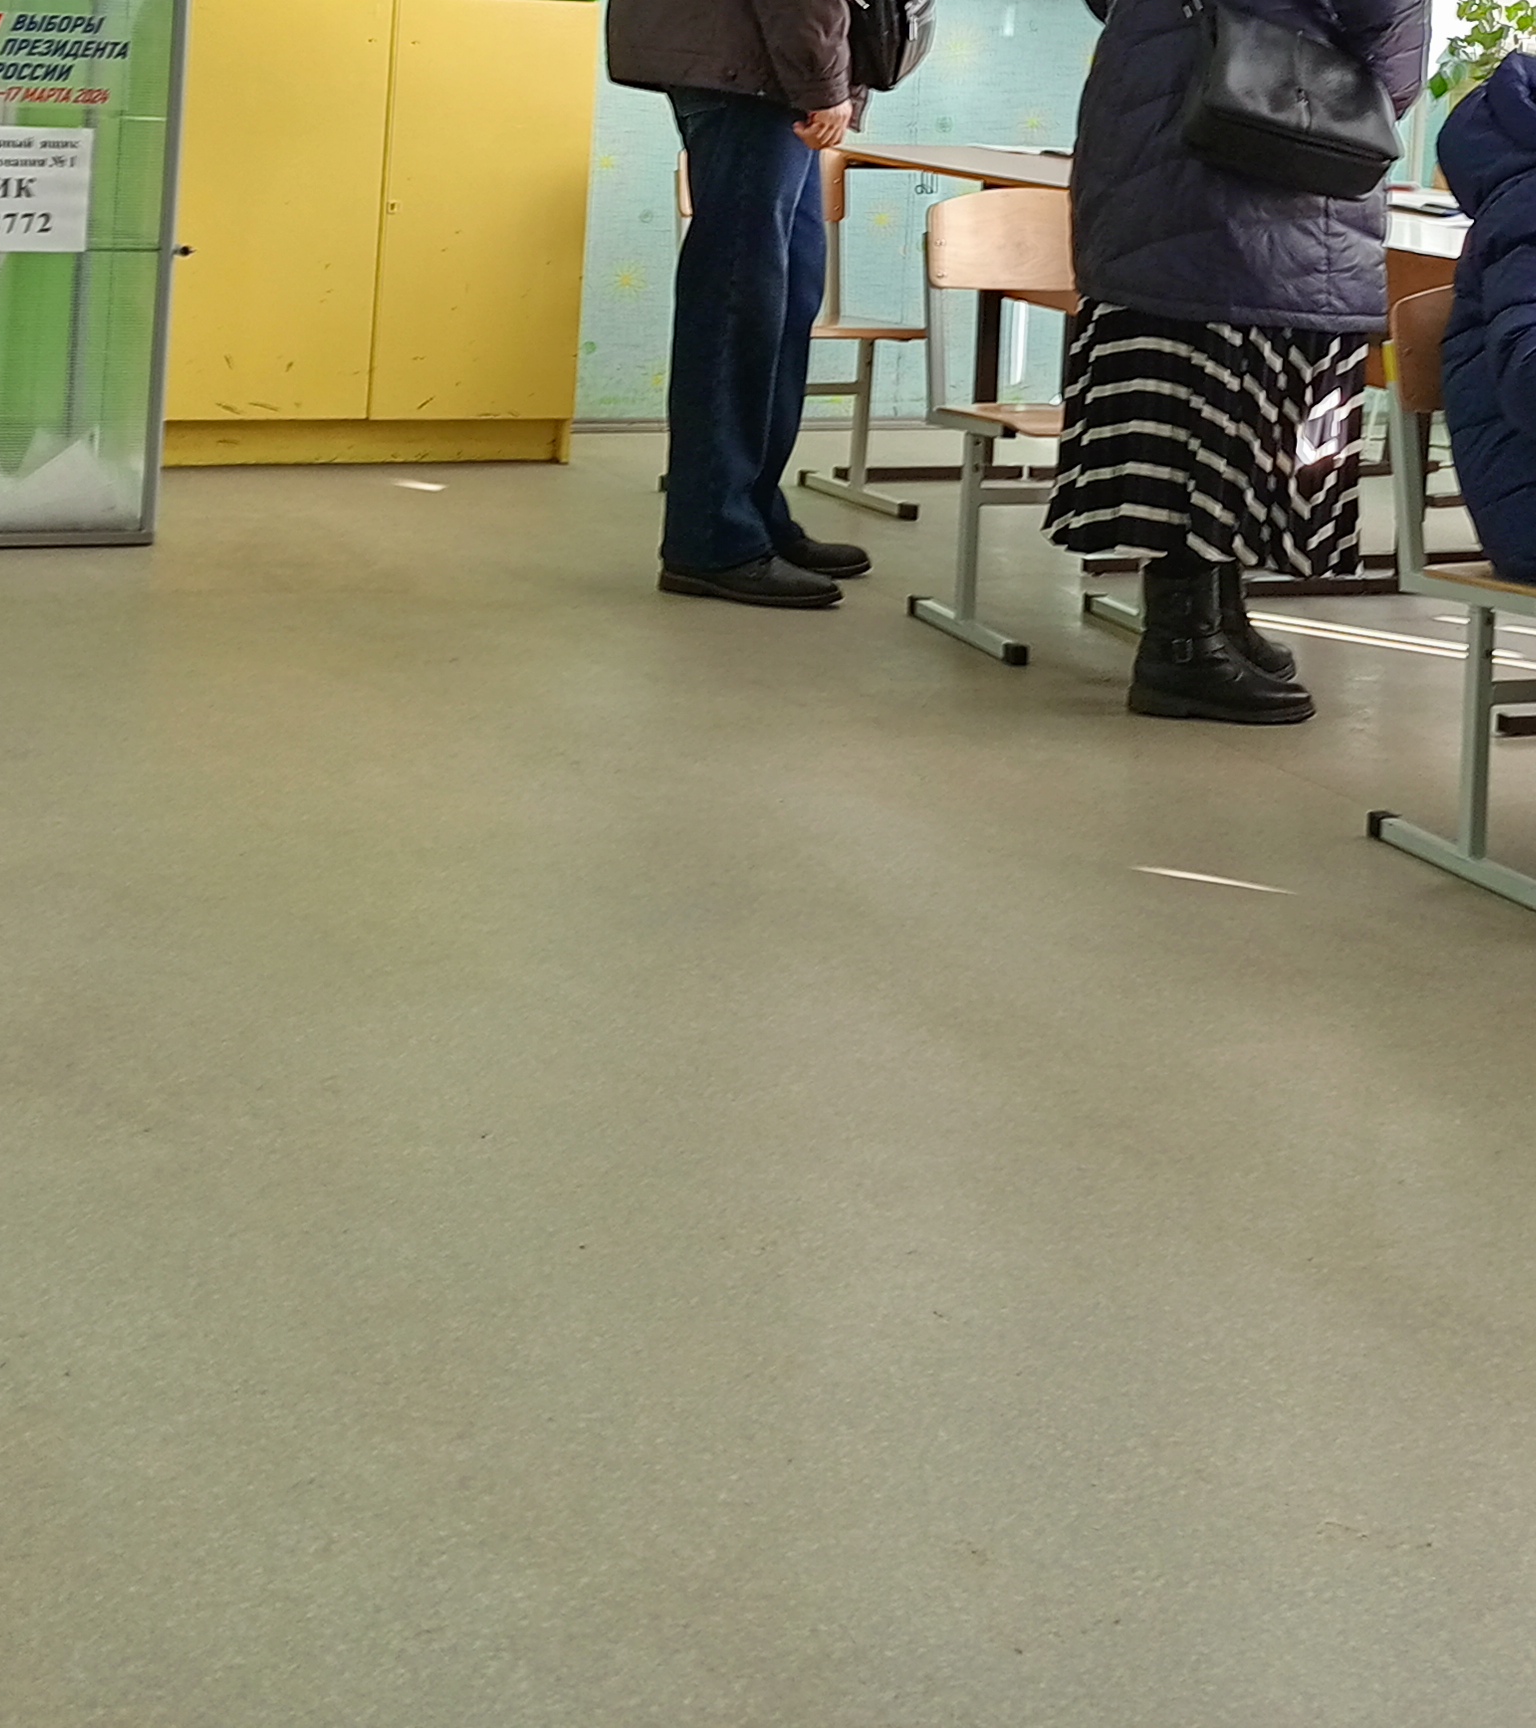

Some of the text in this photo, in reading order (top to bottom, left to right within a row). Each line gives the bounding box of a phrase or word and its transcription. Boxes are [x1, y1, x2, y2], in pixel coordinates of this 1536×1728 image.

[11, 14, 106, 34] ВЫБОРЫ
[0, 38, 132, 60] ПРЕЗИДЕНТА
[21, 86, 73, 103] МАРТА
[72, 88, 110, 105] 2024
[39, 139, 81, 150] ящик
